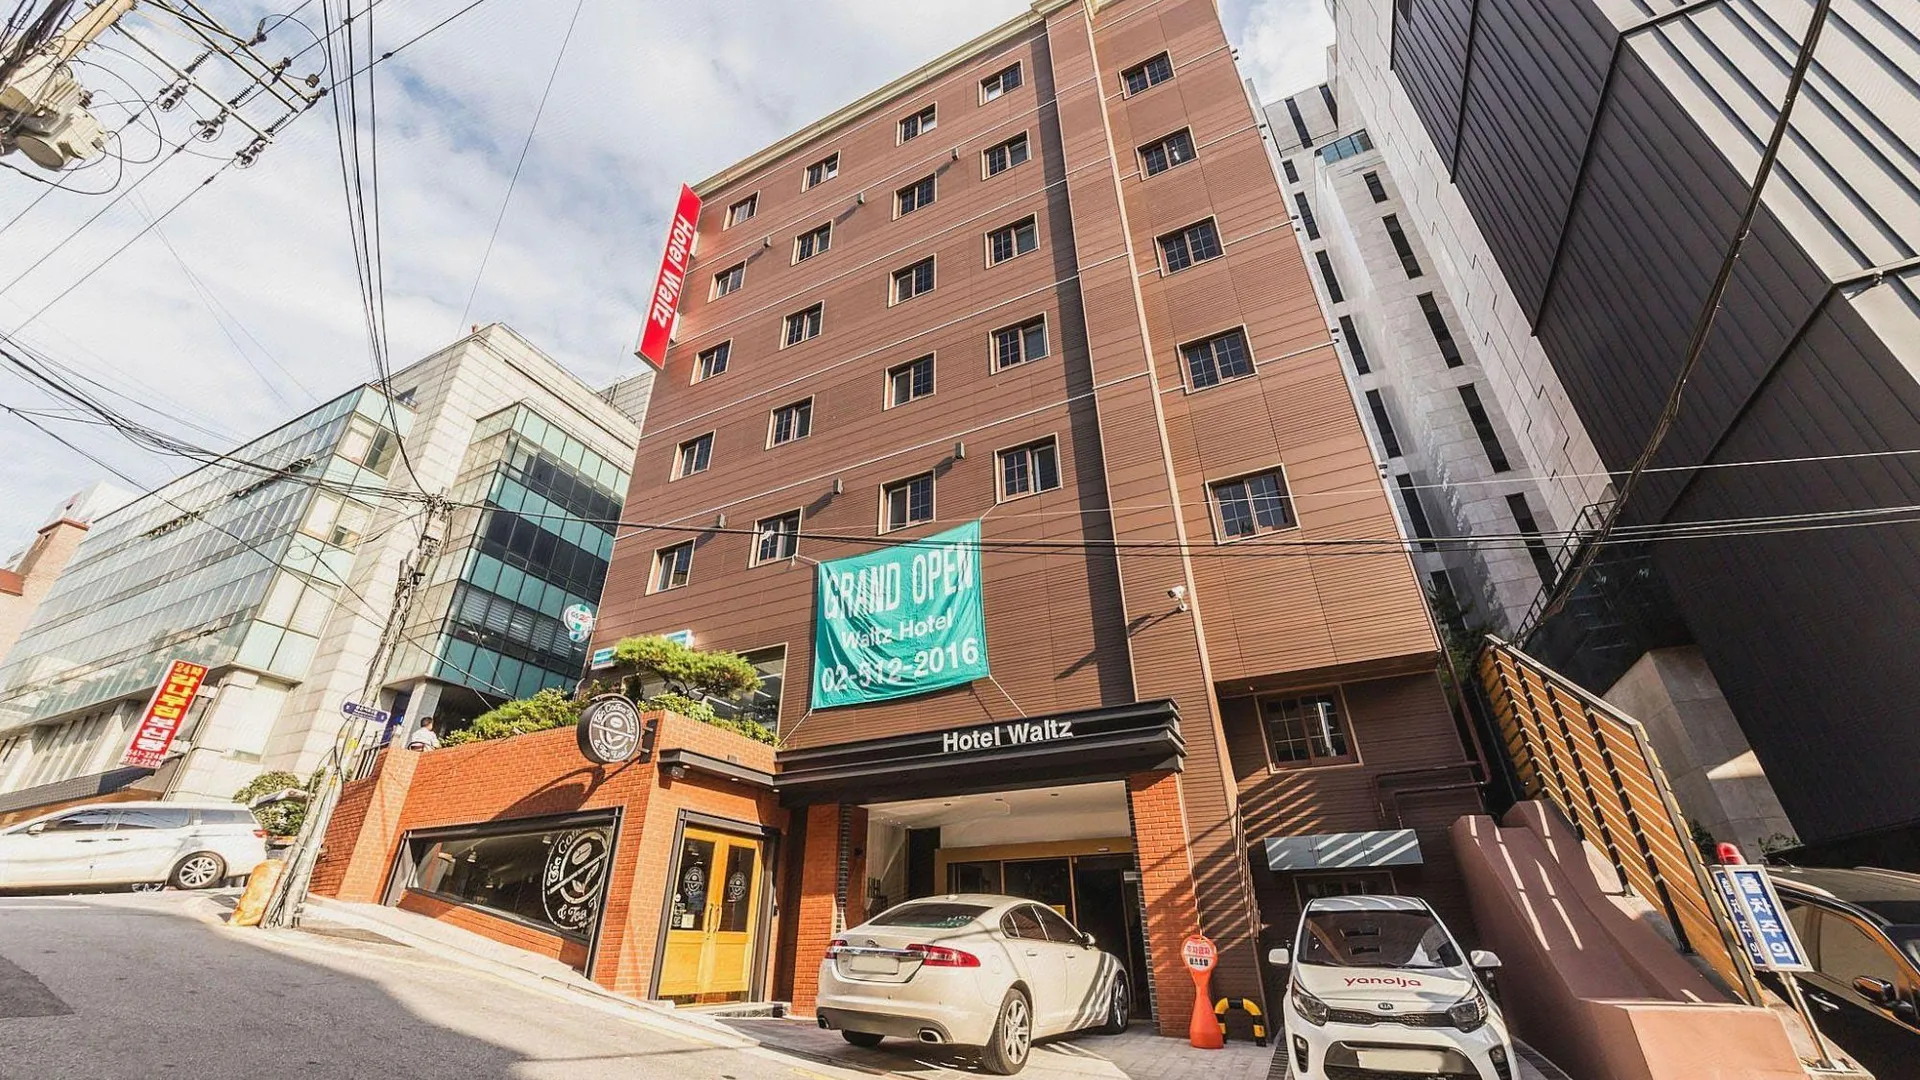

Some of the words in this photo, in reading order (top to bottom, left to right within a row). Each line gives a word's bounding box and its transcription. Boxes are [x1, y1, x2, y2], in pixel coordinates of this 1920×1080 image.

[667, 213, 694, 273] Hotel
[652, 269, 681, 328] Waltz
[823, 562, 900, 620] GRAND
[912, 539, 974, 605] OPEN
[842, 627, 893, 650] Waltz
[900, 608, 954, 640] Hotel
[821, 637, 979, 693] 02-512-2016
[943, 726, 1000, 752] Hotel
[1007, 719, 1074, 745] Waltz
[557, 904, 568, 920] &
[568, 906, 588, 923] Tea
[1740, 873, 1795, 961] 출차주의
[1344, 977, 1422, 988] yanolja
